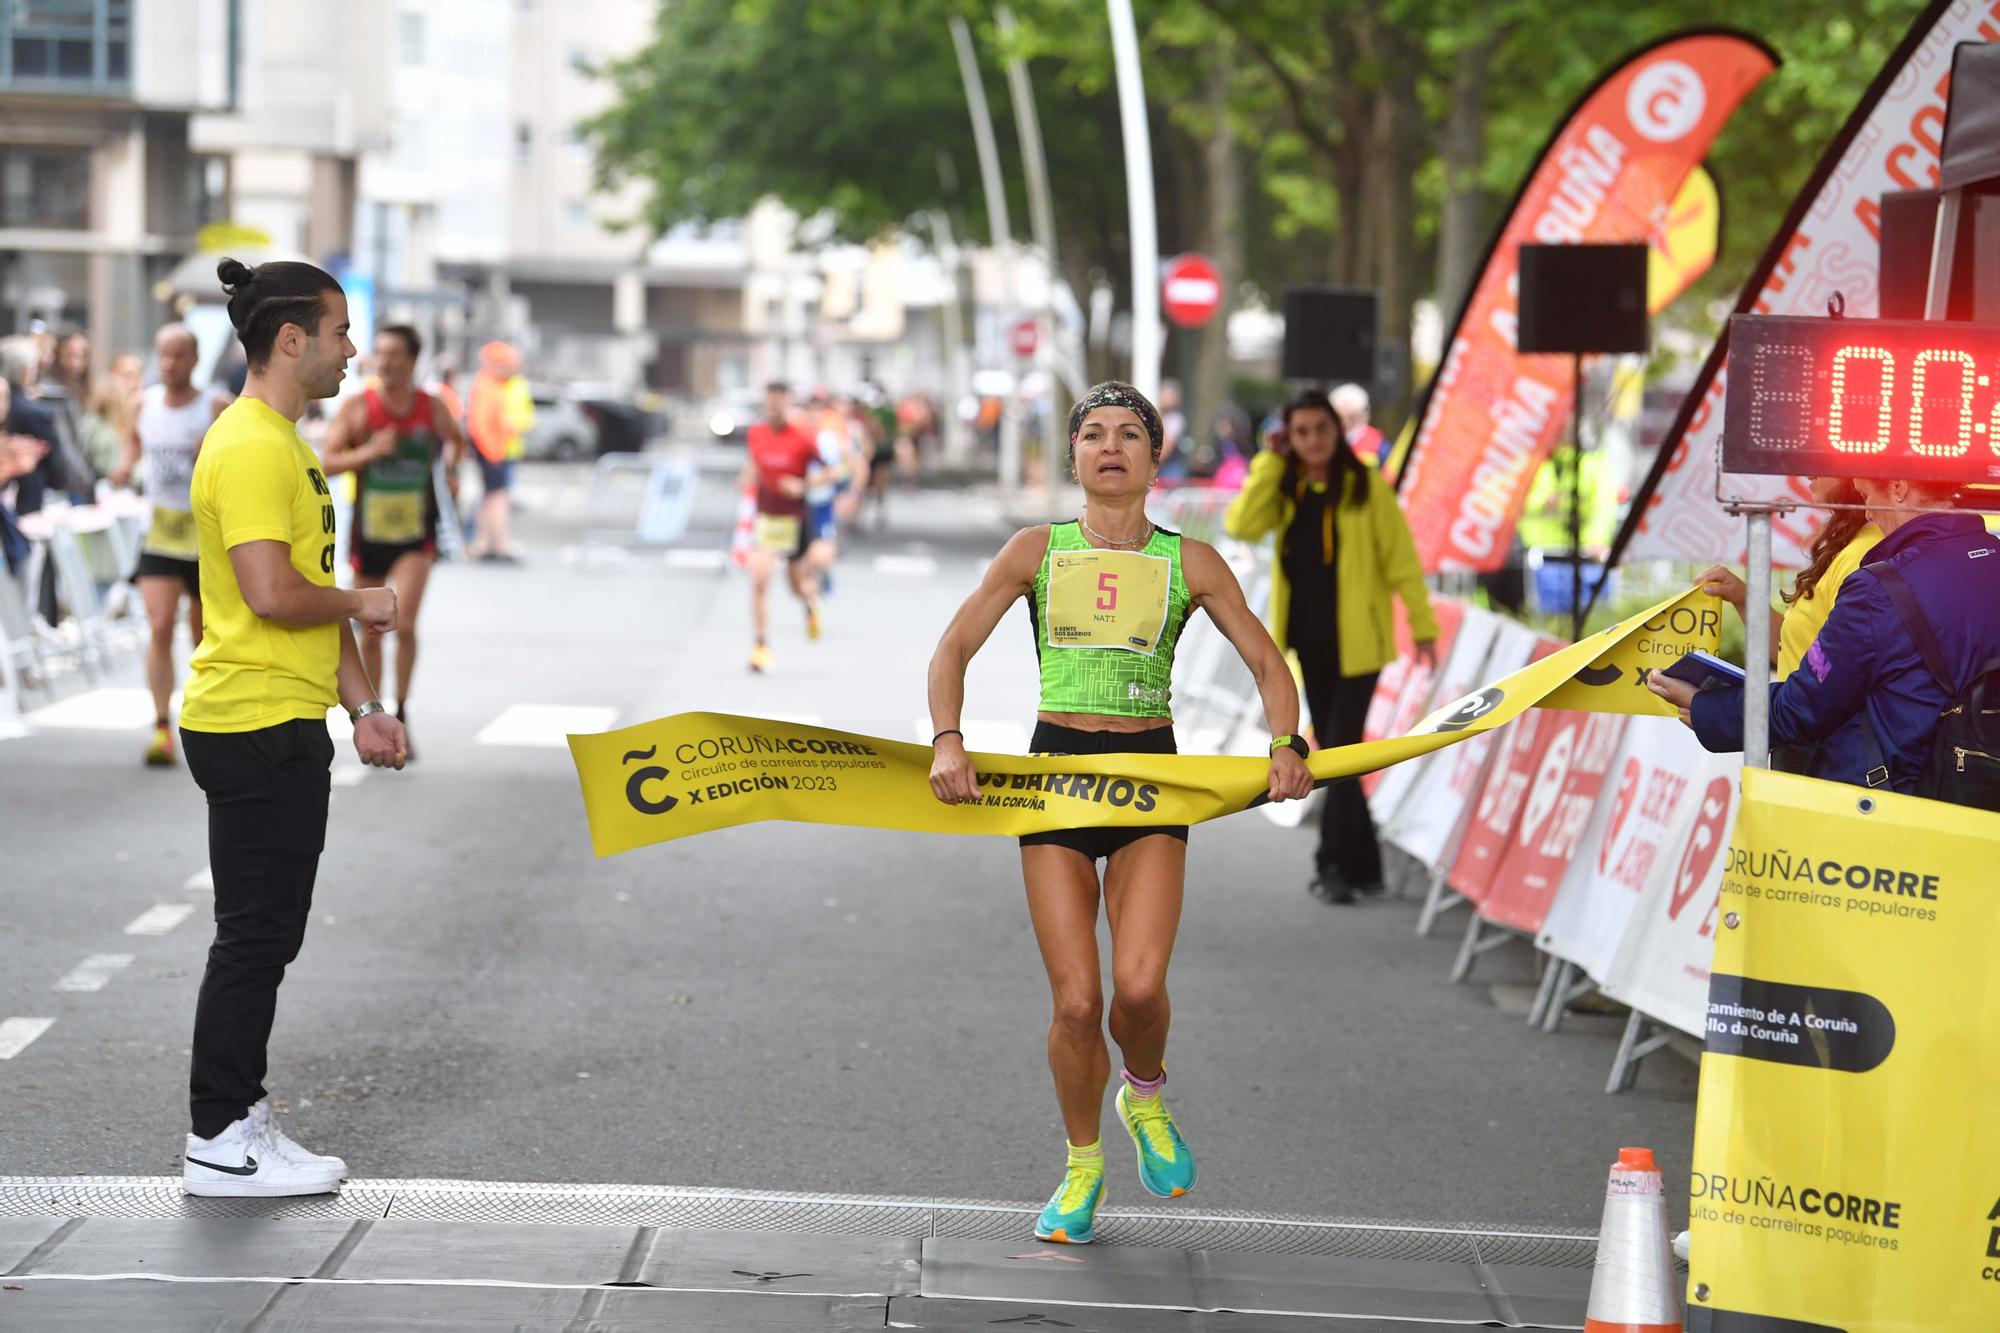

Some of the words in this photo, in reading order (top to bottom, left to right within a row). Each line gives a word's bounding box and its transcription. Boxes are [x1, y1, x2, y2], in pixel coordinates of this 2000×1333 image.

[1829, 345, 2000, 457] 00:
[1450, 376, 1558, 558] CORUÑA
[1096, 572, 1119, 611] 5
[1093, 614, 1117, 623] NATI
[676, 734, 878, 765] CORUÑACORRE
[740, 757, 758, 770] de
[760, 758, 818, 768] carreiras
[821, 758, 886, 771] populares
[688, 790, 704, 805] X
[708, 772, 789, 801] EDICIÓN
[793, 775, 837, 791] 2023
[985, 794, 1001, 807] NA
[1002, 795, 1046, 811] CORUÑA
[1010, 773, 1160, 812] BARRIOS
[1746, 882, 1761, 899] de
[1765, 887, 1842, 908] carreiras
[1846, 897, 1937, 921] populares
[1731, 1020, 1749, 1036] da
[1750, 1024, 1799, 1044] Coruña
[1767, 1009, 1786, 1025] de
[1789, 1012, 1801, 1027] A
[1804, 1014, 1858, 1034] Coruña
[1723, 1209, 1745, 1225] de
[1750, 1212, 1823, 1237] carreiras
[1826, 1227, 1899, 1251] populares
